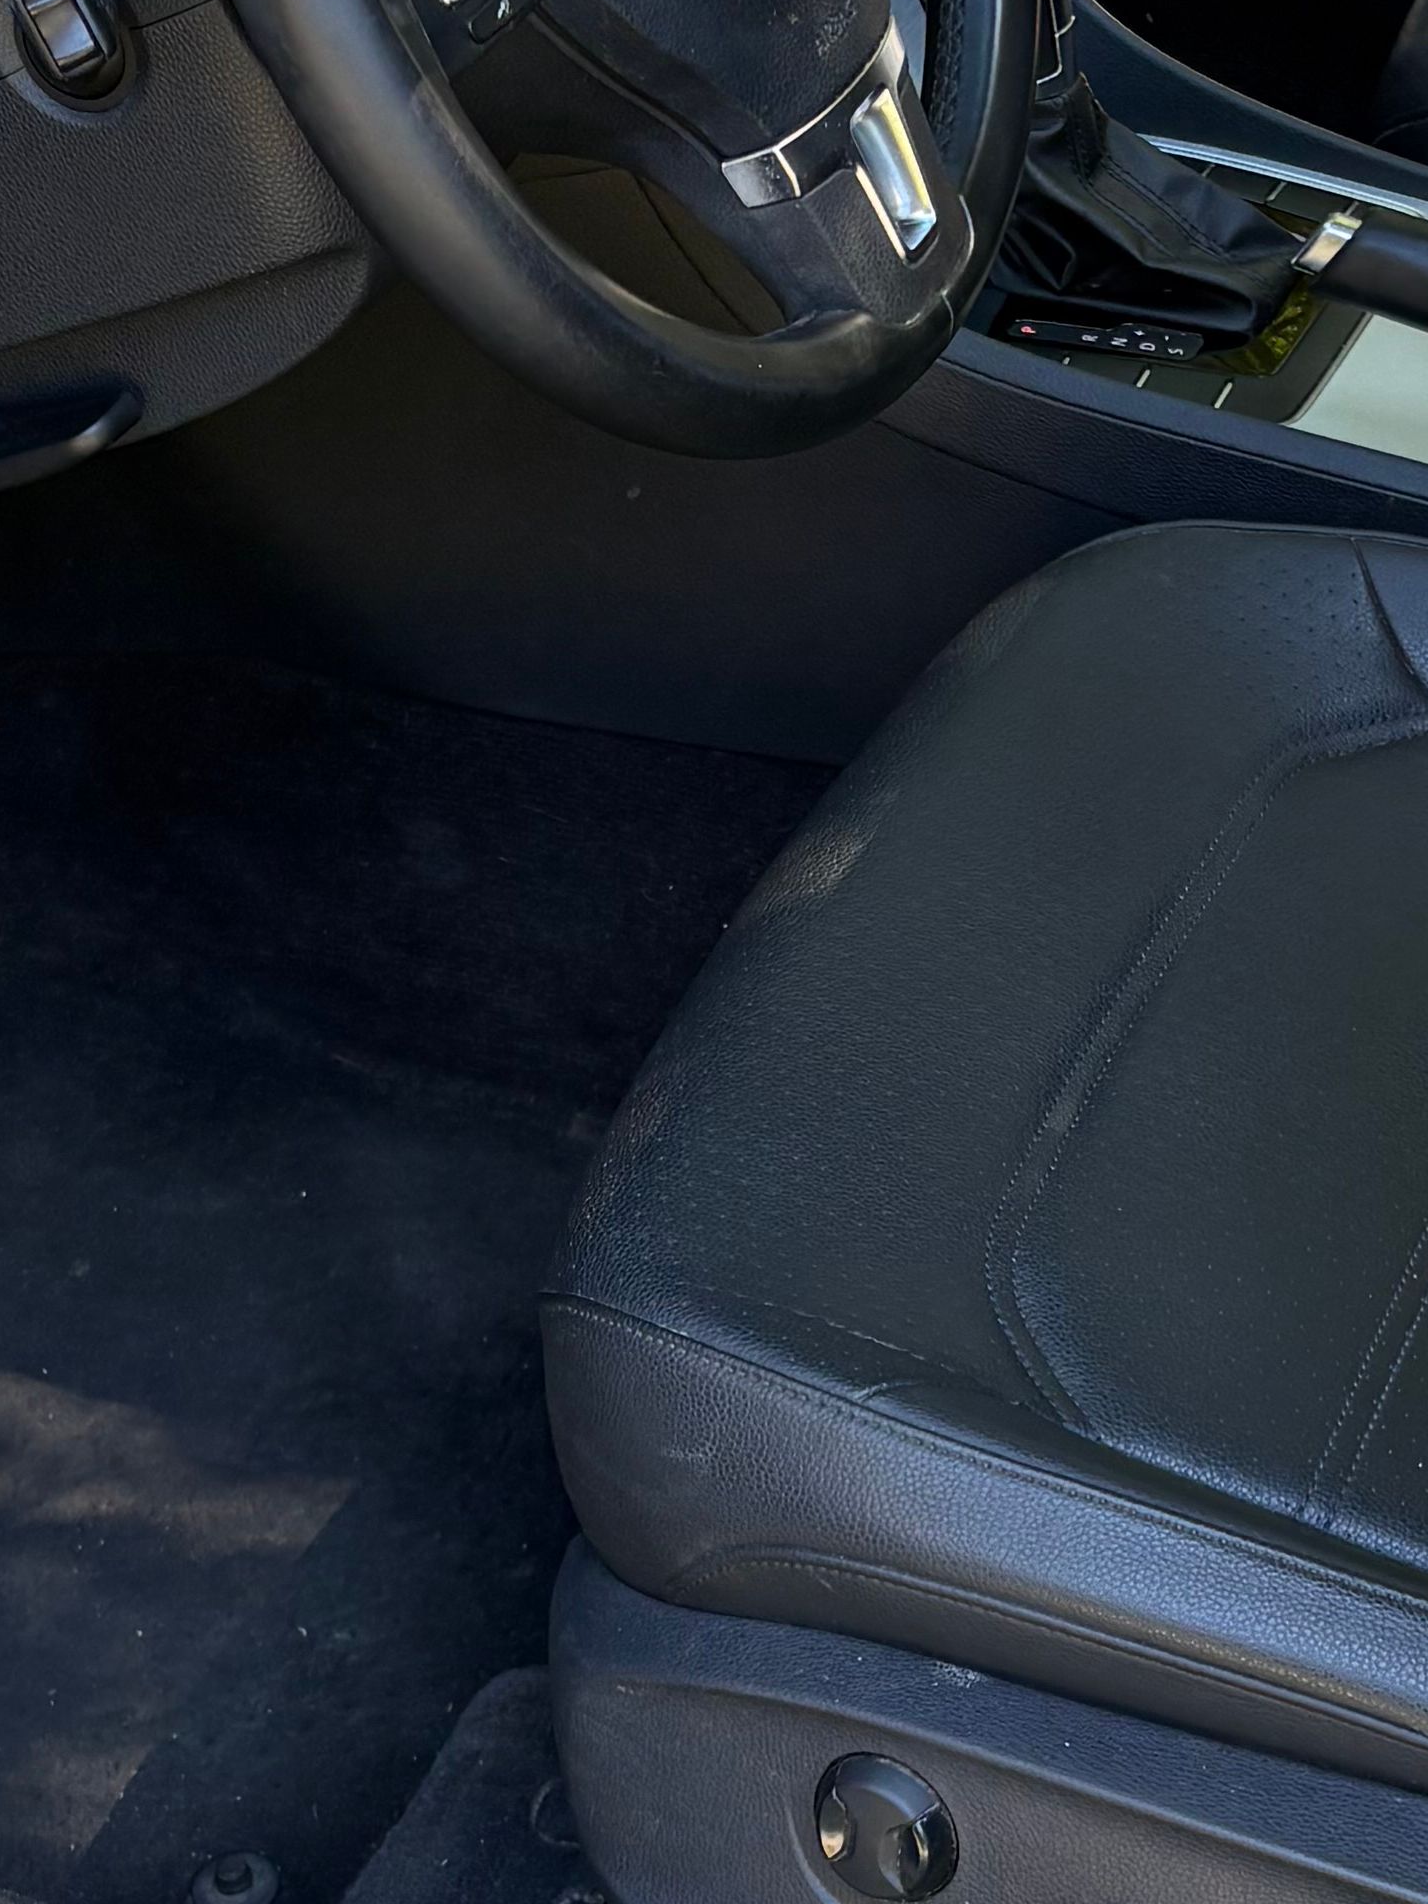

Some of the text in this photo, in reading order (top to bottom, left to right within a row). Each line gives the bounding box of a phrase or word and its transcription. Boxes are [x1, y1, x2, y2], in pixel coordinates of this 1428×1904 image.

[1081, 334, 1099, 343] R
[1139, 342, 1156, 352] D
[1167, 347, 1184, 356] S
